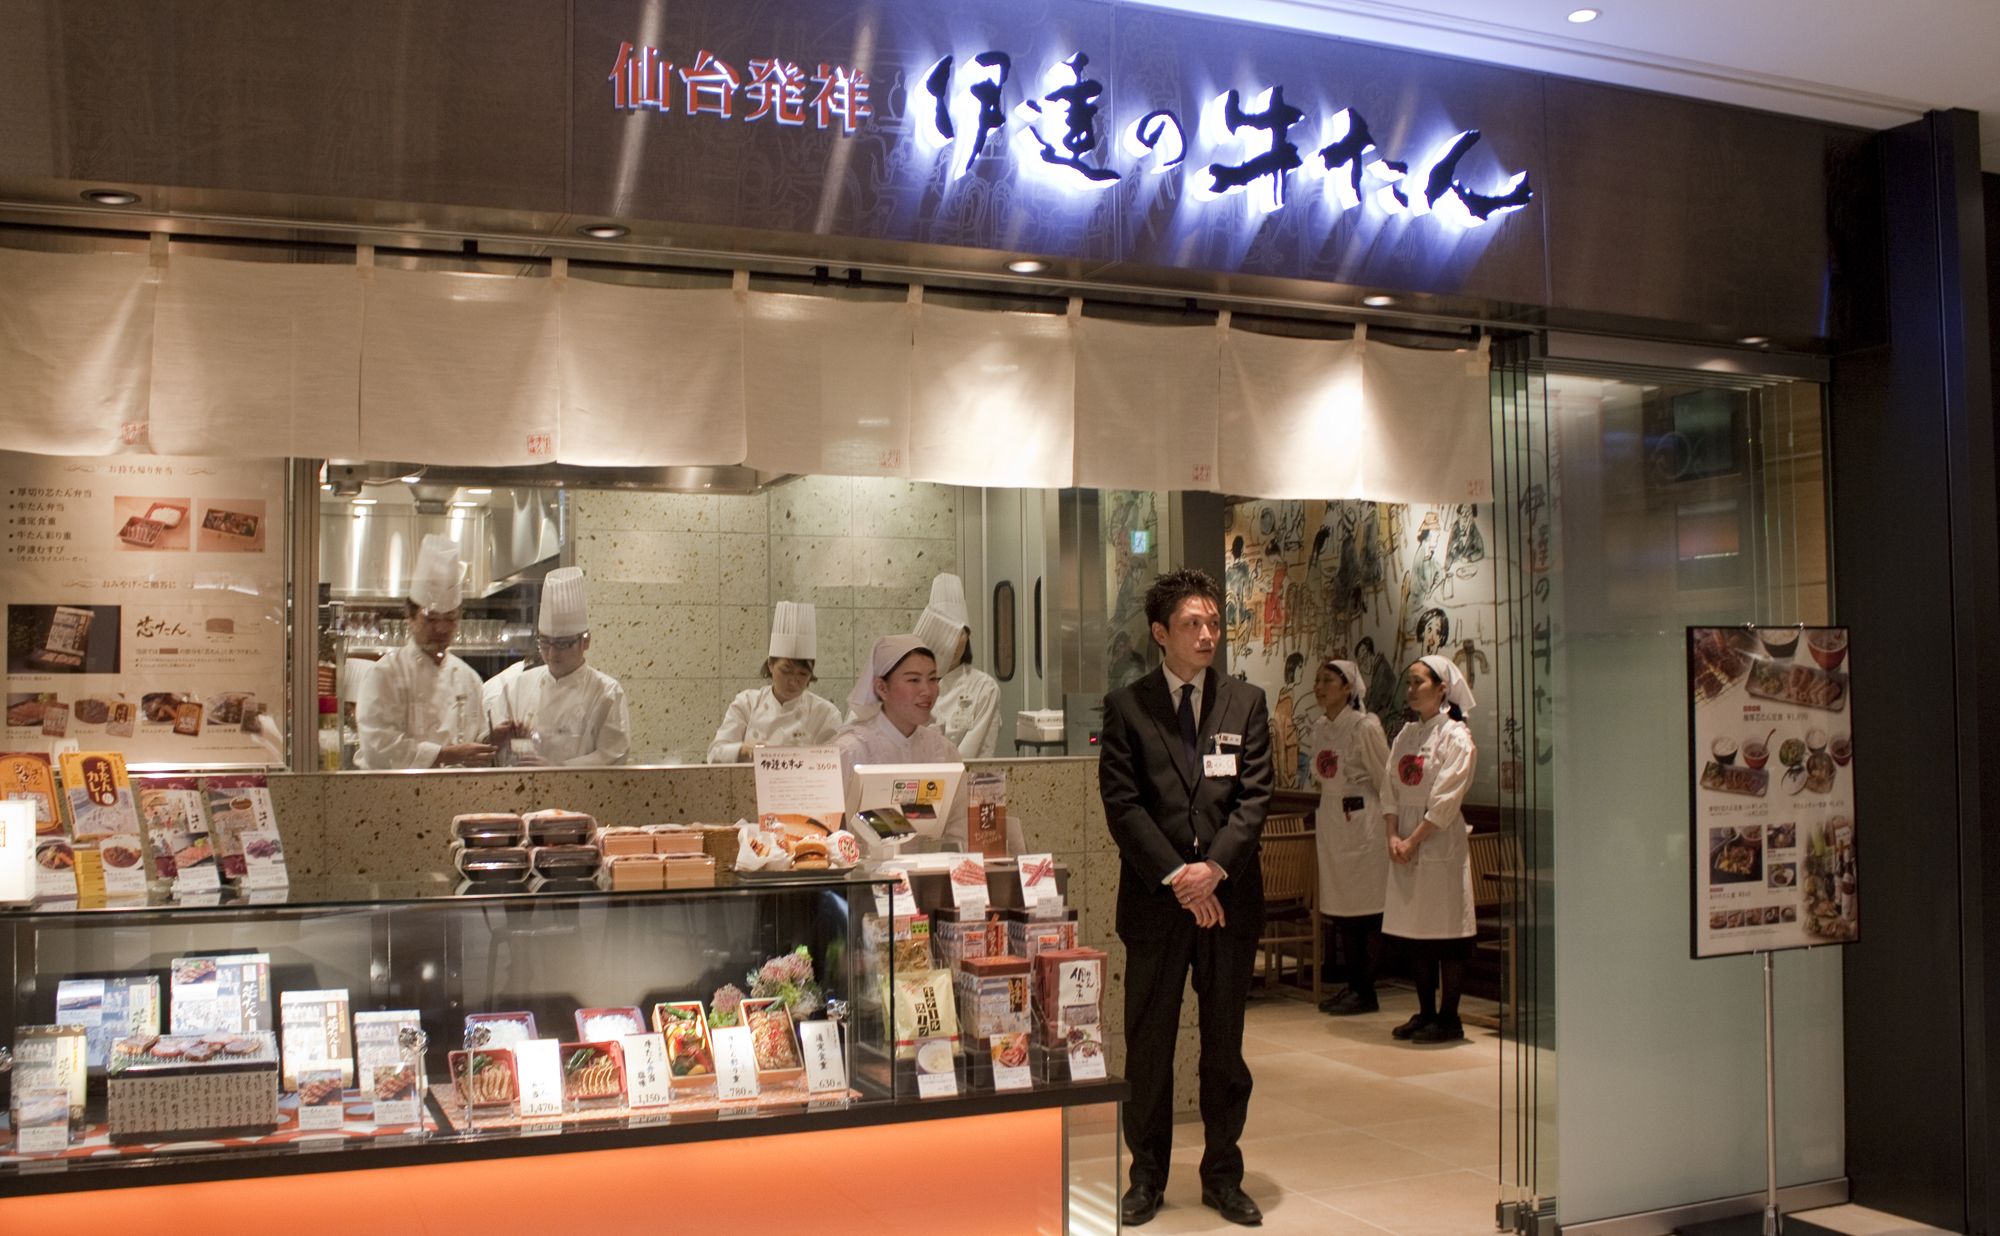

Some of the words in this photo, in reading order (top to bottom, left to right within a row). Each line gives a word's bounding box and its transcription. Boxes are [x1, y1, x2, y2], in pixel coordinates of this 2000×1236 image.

[608, 41, 871, 132] 仙台発祥
[915, 50, 1534, 228] 伊達の牛たん
[108, 464, 173, 475] お持ち帰り弁当
[17, 502, 65, 511] 牛たん弁当
[17, 531, 72, 540] 牛たん彩り重
[17, 545, 64, 554] 伊達むすび
[136, 615, 187, 638] 芯たん
[816, 762, 837, 771] 360円
[97, 761, 112, 791] 牛たん
[87, 769, 100, 802] カレー
